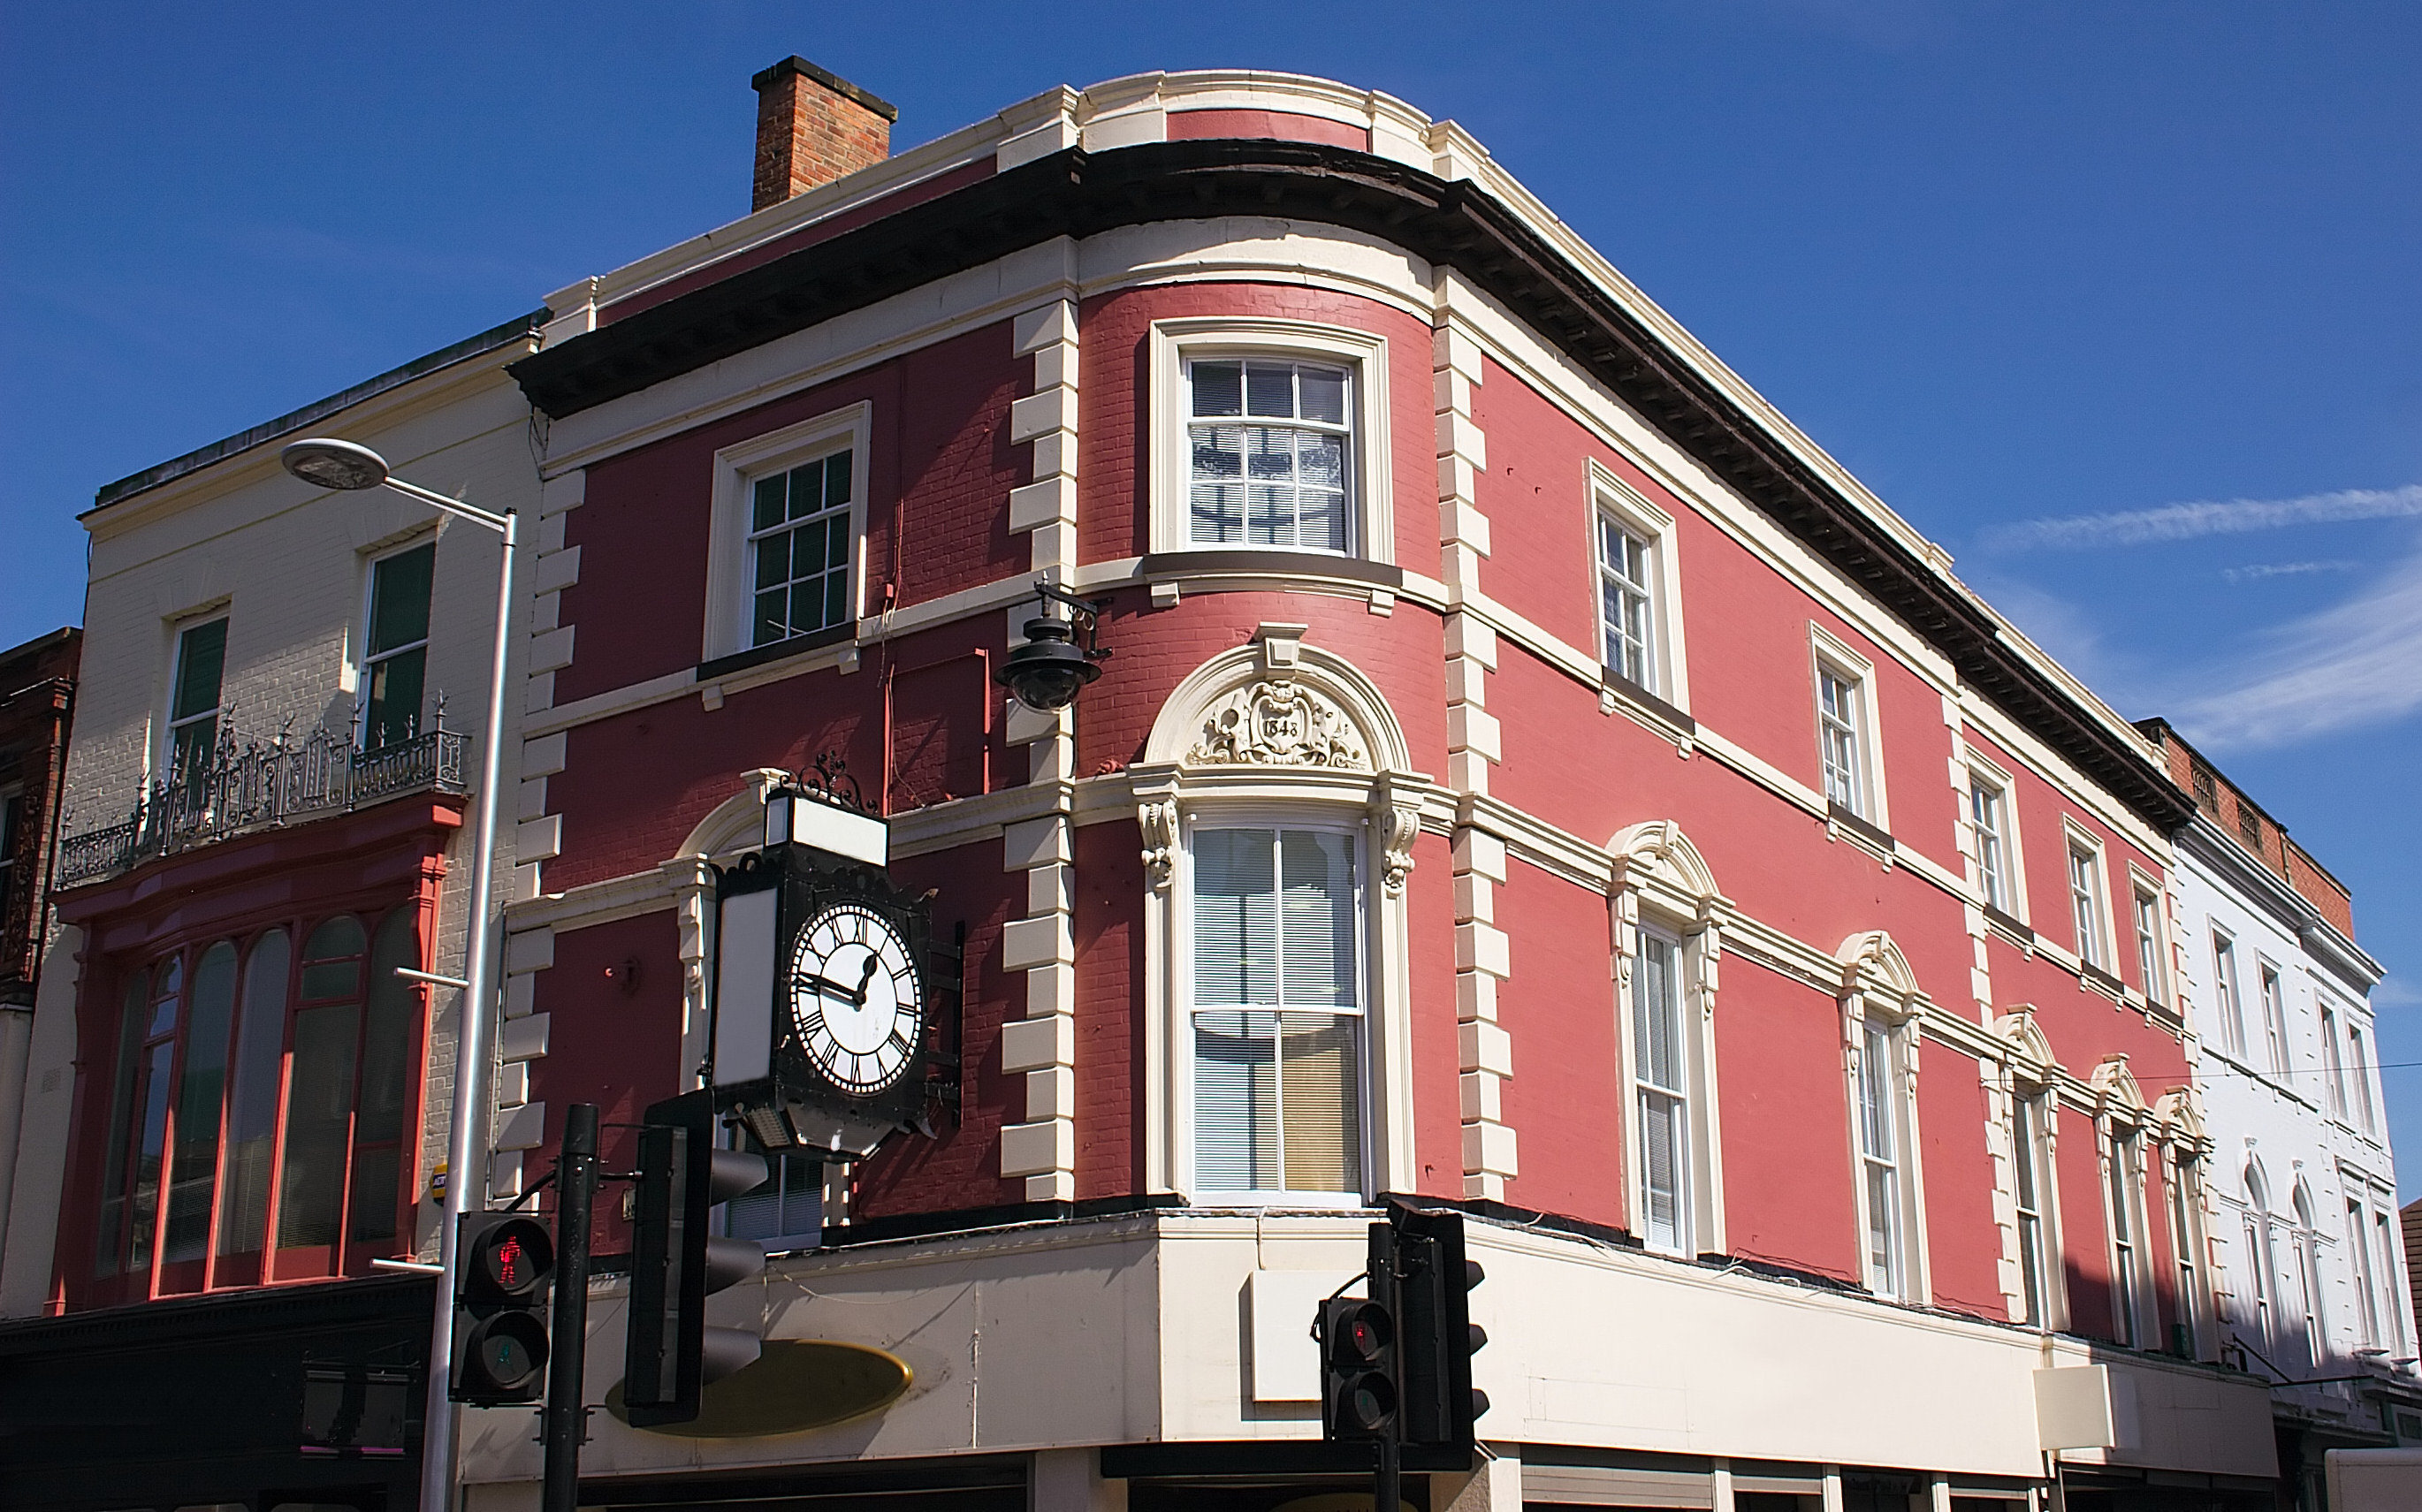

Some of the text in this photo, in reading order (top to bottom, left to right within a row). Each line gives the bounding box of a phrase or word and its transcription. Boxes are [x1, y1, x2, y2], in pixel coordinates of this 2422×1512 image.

[826, 916, 844, 947] XI
[854, 914, 868, 944] XII
[804, 938, 828, 967] X
[891, 967, 910, 982] II
[896, 1000, 916, 1018] III
[799, 1009, 826, 1042] VIII
[820, 1037, 840, 1072] VII
[849, 1053, 862, 1084] VI
[875, 1050, 890, 1079] V
